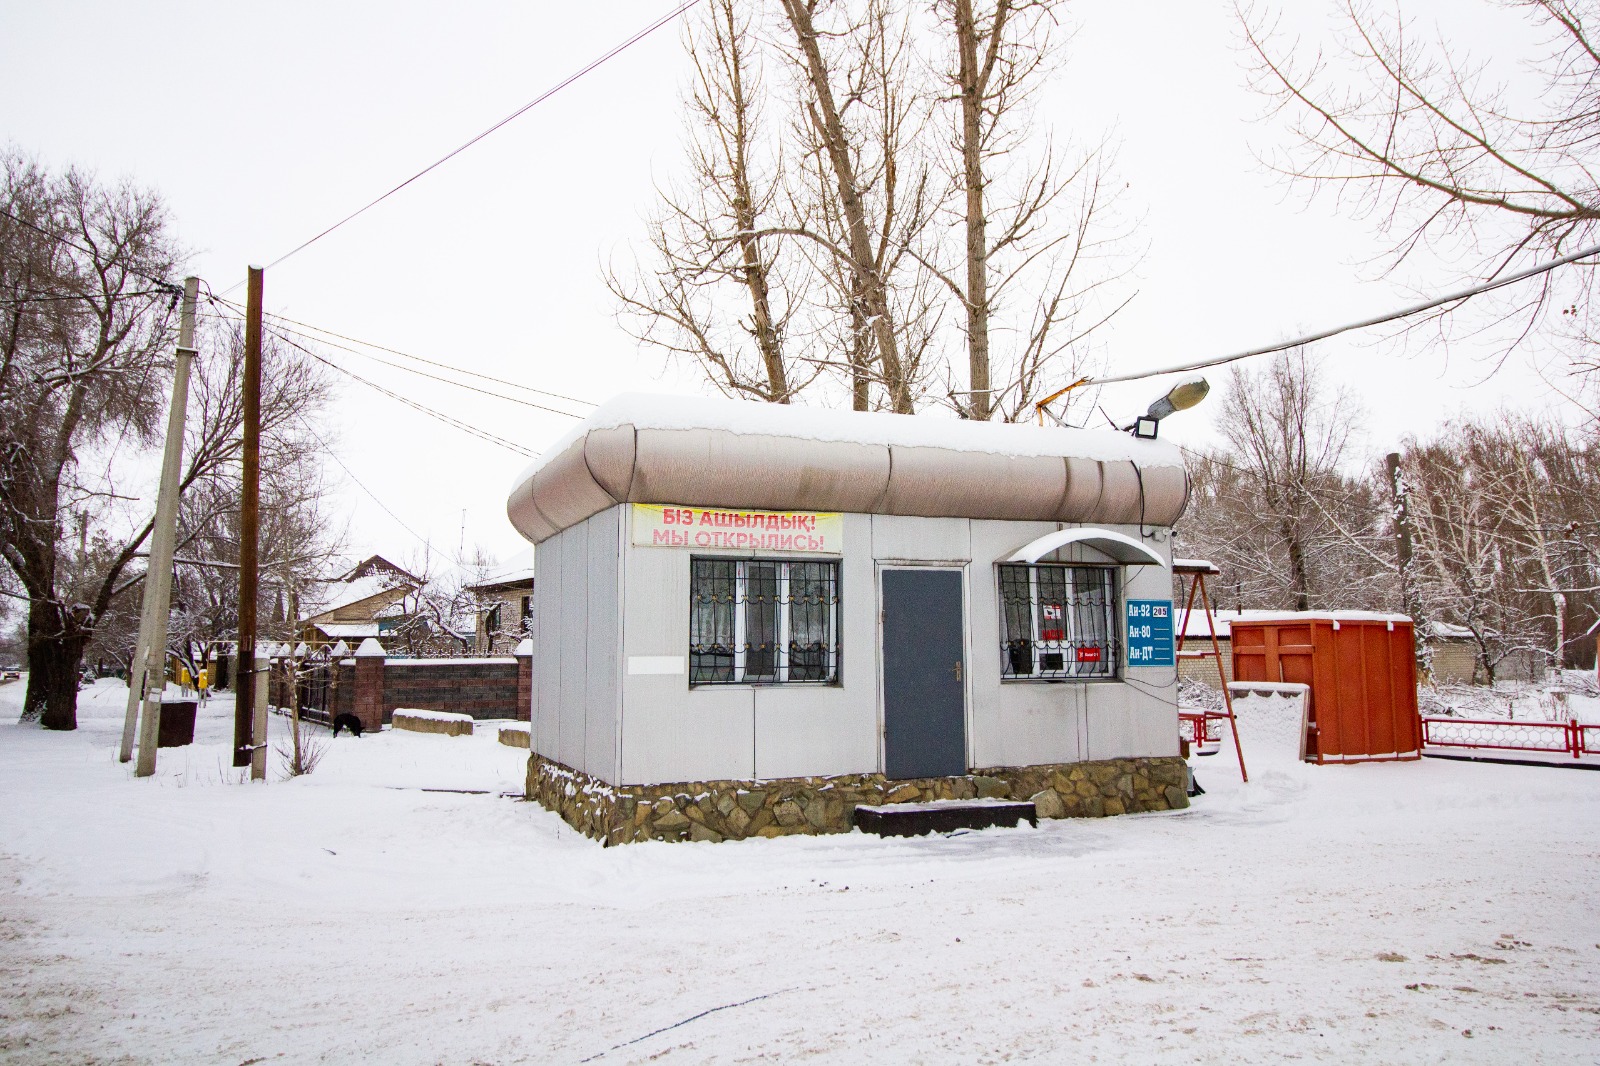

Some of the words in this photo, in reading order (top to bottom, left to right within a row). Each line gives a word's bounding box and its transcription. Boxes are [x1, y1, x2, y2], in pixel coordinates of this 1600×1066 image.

[663, 508, 693, 526] БІЗ
[699, 511, 815, 531] АШЫЛДЫҚ!
[653, 528, 688, 546] МЫ
[695, 531, 824, 550] ОТКРЫЛИСЬ!
[1154, 607, 1167, 616] 205
